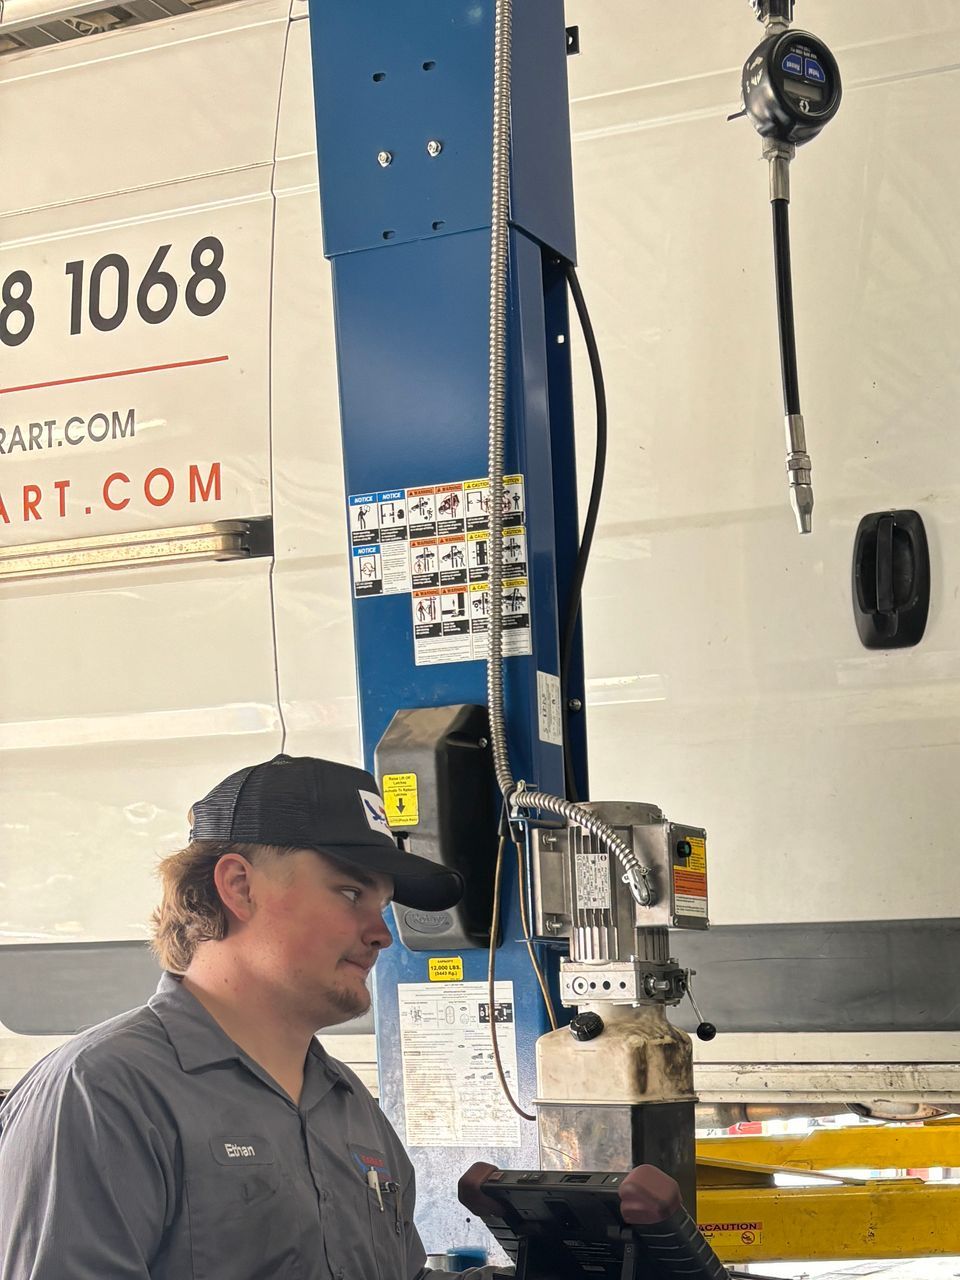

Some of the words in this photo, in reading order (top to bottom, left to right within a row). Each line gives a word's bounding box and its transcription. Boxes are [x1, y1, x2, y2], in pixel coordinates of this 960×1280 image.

[0, 270, 35, 347] 8
[65, 236, 227, 335] 1068
[354, 495, 373, 503] NOTICE
[382, 492, 401, 500] NOTICE
[357, 546, 377, 554] NOTICE
[224, 1143, 256, 1158] Ethan
[704, 1222, 757, 1231] CAUTION
